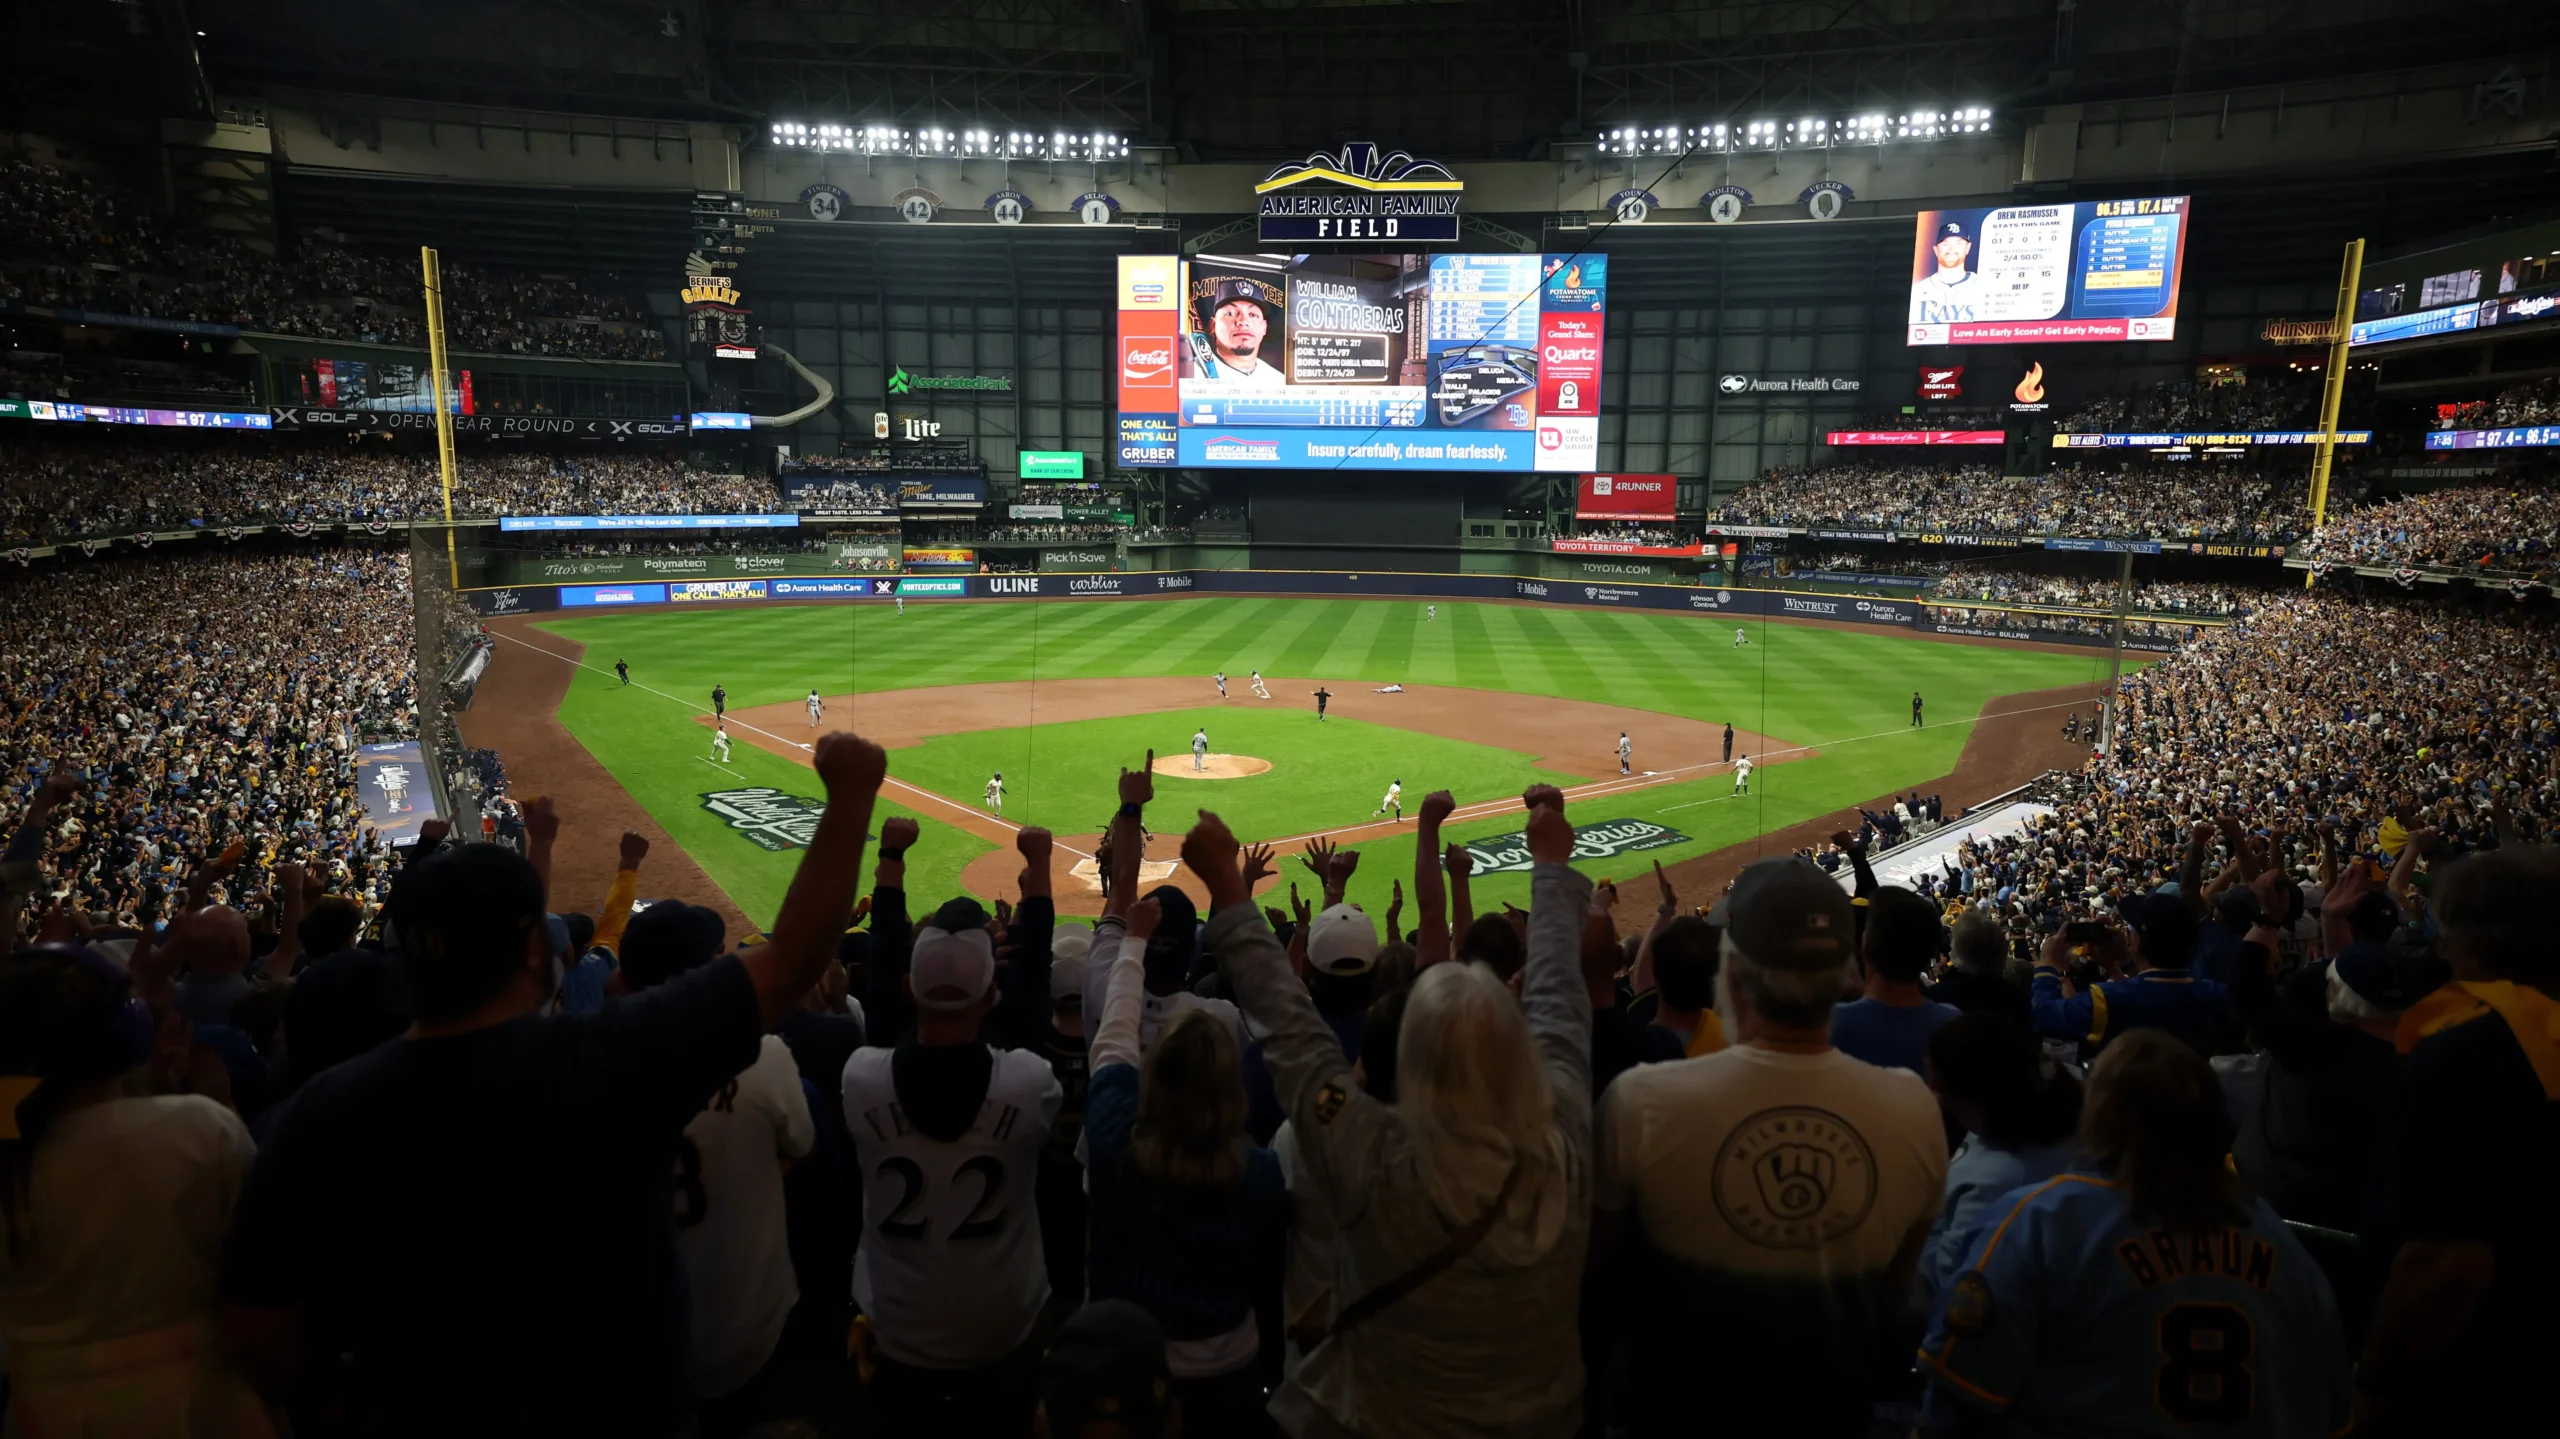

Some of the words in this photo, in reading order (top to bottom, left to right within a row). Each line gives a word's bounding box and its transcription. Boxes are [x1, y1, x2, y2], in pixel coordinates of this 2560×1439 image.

[807, 184, 842, 196] FINGERS
[1707, 186, 1746, 200] MOLITOR
[1809, 182, 1843, 194] UECKER
[995, 190, 1022, 201] AARON
[1083, 192, 1108, 202] SELIG
[813, 196, 836, 218] 34
[906, 200, 930, 219] 42
[1259, 195, 1373, 216] AMERICAN
[1380, 195, 1460, 216] FAMILY
[1621, 201, 1644, 221] 19
[1717, 200, 1732, 219] 4
[2096, 202, 2121, 217] 96.5
[2138, 199, 2161, 215] 97.4
[997, 204, 1021, 222] 44
[1091, 206, 1102, 223] 1
[1997, 210, 2017, 221] DREW
[2017, 208, 2059, 220] RASMUSSEN
[1318, 218, 1398, 238] FIELD
[689, 276, 732, 289] BERNIE'S
[681, 286, 741, 307] CHALET
[1296, 280, 1358, 302] WILLIAM
[1549, 288, 1597, 296] POTAWATOMI
[1295, 299, 1404, 333] CONTRERAS
[1557, 321, 1587, 331] Today's
[1953, 329, 1975, 338] Love
[1975, 329, 1989, 337] An
[1989, 327, 2013, 338] Early
[2013, 327, 2043, 337] Score?
[2044, 326, 2061, 336] Get
[2062, 326, 2087, 337] Early
[2087, 325, 2124, 336] Payday.
[1547, 331, 1572, 339] Grand
[1573, 330, 1596, 339] Slam:
[1127, 350, 1169, 366] Coca-Cola
[1296, 347, 1316, 356] DOB:
[1544, 345, 1597, 364] Quartz
[1296, 368, 1325, 378] DEBUT:
[1325, 368, 1356, 378] 7/24/20
[1927, 370, 1955, 383] Miller
[1748, 378, 1788, 391] Aurora
[1790, 377, 1829, 391] Health
[1831, 378, 1860, 391] Care
[188, 413, 223, 427] 97.4
[244, 416, 269, 427] 7:35
[306, 411, 359, 424] GOLF
[389, 413, 438, 429] OPEN
[503, 417, 575, 434] ROUND
[637, 423, 686, 434] GOLF
[1120, 419, 1143, 430] ONE
[1144, 419, 1177, 430] CALL...
[904, 418, 941, 441] Lite
[1120, 432, 1155, 442] THAT'S
[1156, 432, 1177, 442] ALL!
[1564, 433, 1593, 442] credit
[2106, 436, 2125, 446] TEXT
[2127, 434, 2173, 445] "BREWERS"
[2182, 434, 2205, 447] (414)
[2254, 433, 2264, 443] TO
[2263, 433, 2278, 444] SIGN
[2278, 433, 2288, 443] UP
[2288, 433, 2303, 443] FOR
[2486, 431, 2514, 447] 97.4
[2526, 429, 2550, 444] 96.5
[1205, 445, 1247, 453] AMERICAN
[1247, 446, 1278, 454] FAMILY
[1307, 442, 1345, 458] Insure
[1347, 442, 1403, 461] carefully,
[1405, 442, 1444, 459] dream
[1445, 443, 1508, 462] fearlessly.
[1564, 442, 1594, 450] union
[1121, 447, 1176, 460] GRUBER
[898, 484, 934, 499] Miller
[1615, 482, 1662, 492] 4RUNNER
[916, 493, 935, 501] TIME,
[935, 493, 976, 501] MILWAUKEE
[1921, 534, 1943, 543] 620
[1944, 535, 1979, 545] WTMJ
[840, 545, 889, 558] Johnsonville
[1555, 542, 1587, 551] TOYOTA
[1589, 543, 1635, 552] TERRITORY
[2104, 541, 2155, 553] WINTRUST
[2206, 545, 2246, 557] NICOLET
[2248, 547, 2270, 558] LAW
[644, 558, 707, 569] Polymatech
[748, 556, 785, 568] clover
[910, 552, 947, 565] Surfside
[1045, 552, 1069, 563] Pick
[1078, 552, 1106, 563] Save
[545, 564, 578, 577] Tito's
[1582, 563, 1651, 575] TOYOTA.COM
[1741, 557, 1772, 573] Culver's
[686, 583, 726, 593] GRUBER
[728, 581, 750, 591] LAW
[791, 584, 818, 592] Aurora
[818, 583, 843, 592] Health
[843, 583, 863, 592] Care
[902, 583, 961, 591] VORTEXOPTICS.COM
[989, 577, 1039, 592] ULINE
[1069, 575, 1122, 590] carbliss
[1166, 576, 1193, 588] Mobile
[1523, 582, 1548, 596] Mobile
[1598, 588, 1639, 597] Northwestern
[1693, 601, 1718, 609] Controls
[1784, 598, 1837, 612] WINTRUST
[1871, 605, 1896, 613] Aurora
[1870, 611, 1894, 621] Health
[1895, 613, 1912, 622] Care
[1735, 1120, 1860, 1167] MILWAUKEE
[875, 1155, 1007, 1240] 22
[2114, 1226, 2276, 1293] BRAUN
[2153, 1300, 2257, 1427] 8
